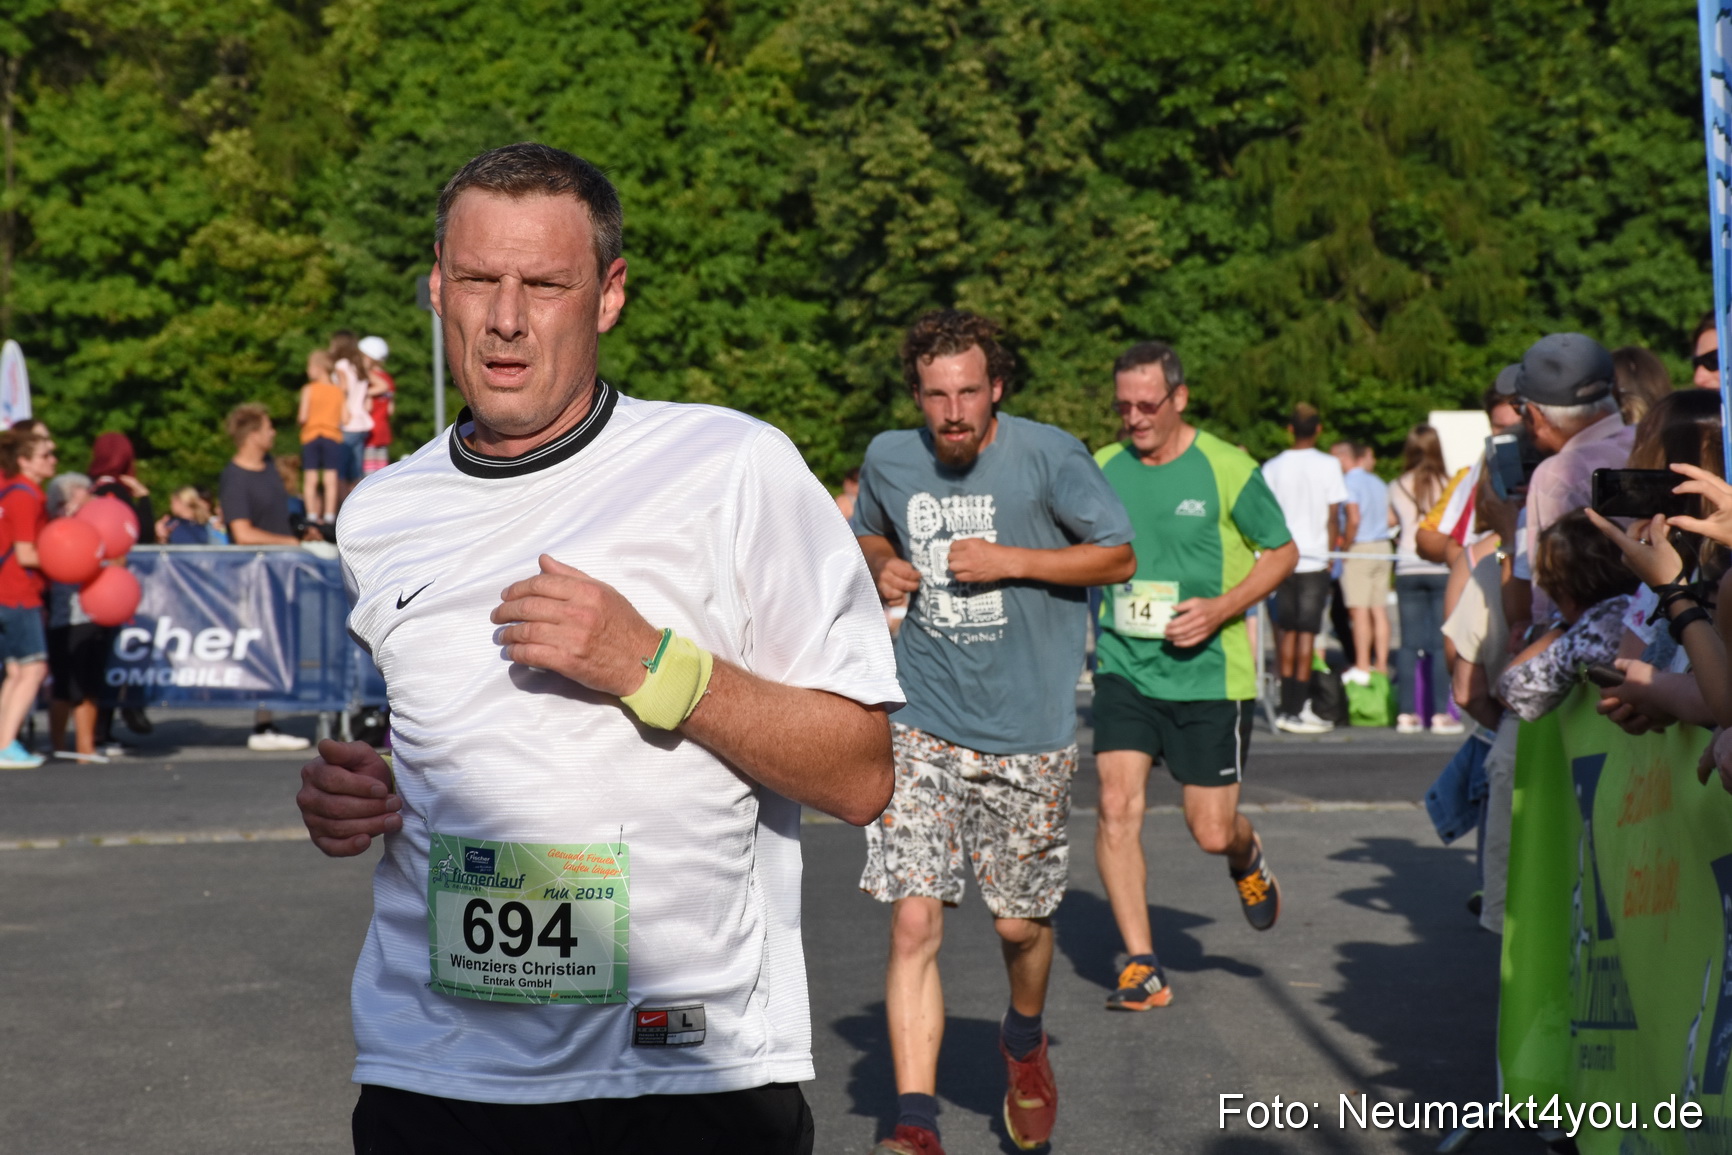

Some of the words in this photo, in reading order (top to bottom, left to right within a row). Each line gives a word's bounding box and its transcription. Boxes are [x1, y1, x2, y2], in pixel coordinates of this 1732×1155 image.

[1129, 602, 1152, 620] 14
[113, 615, 263, 662] cher
[104, 666, 244, 687] OMOBILE
[547, 848, 585, 862] Gesunde
[563, 860, 590, 873] laufen
[452, 867, 526, 889] firmenlauf
[543, 887, 570, 900] run
[575, 887, 614, 900] 2019
[463, 898, 578, 958] 694
[450, 953, 517, 975] Wienziers
[522, 960, 596, 976] Christian
[483, 975, 515, 987] Entrak
[518, 977, 552, 989] GmbH
[682, 1013, 693, 1028] L
